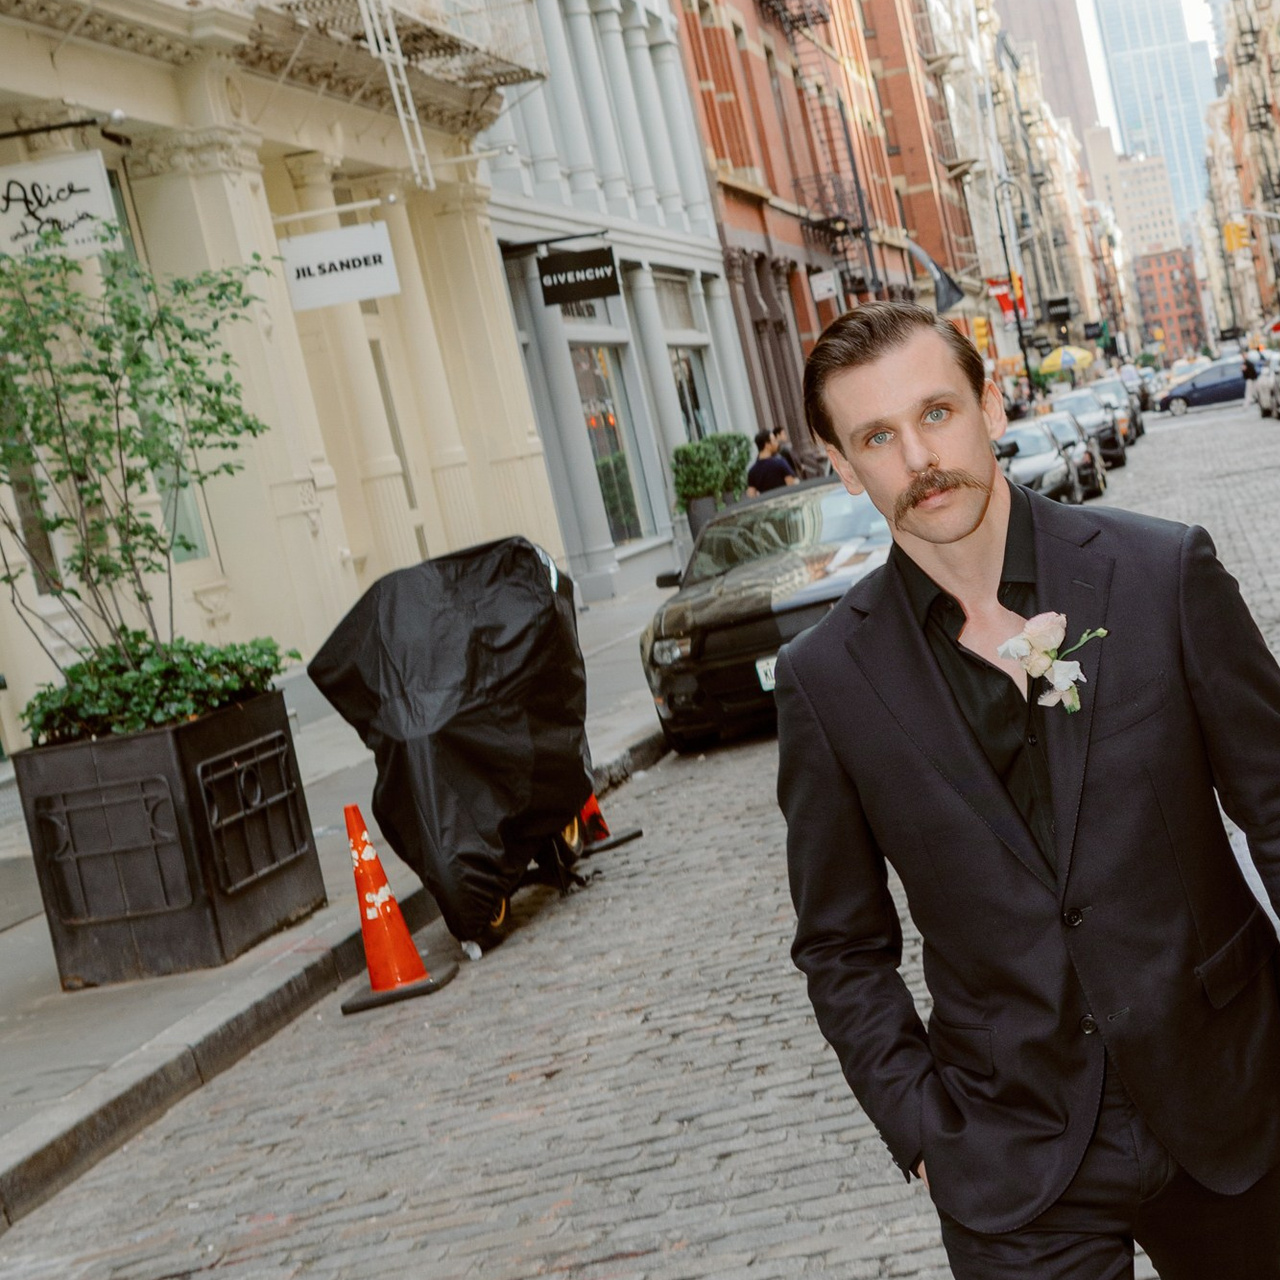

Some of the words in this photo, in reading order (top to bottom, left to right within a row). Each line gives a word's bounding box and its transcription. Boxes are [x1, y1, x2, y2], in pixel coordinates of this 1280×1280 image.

[0, 180, 90, 217] Alice
[295, 266, 315, 280] JIL
[317, 254, 383, 276] SANDER
[542, 265, 613, 287] GIVENCHY
